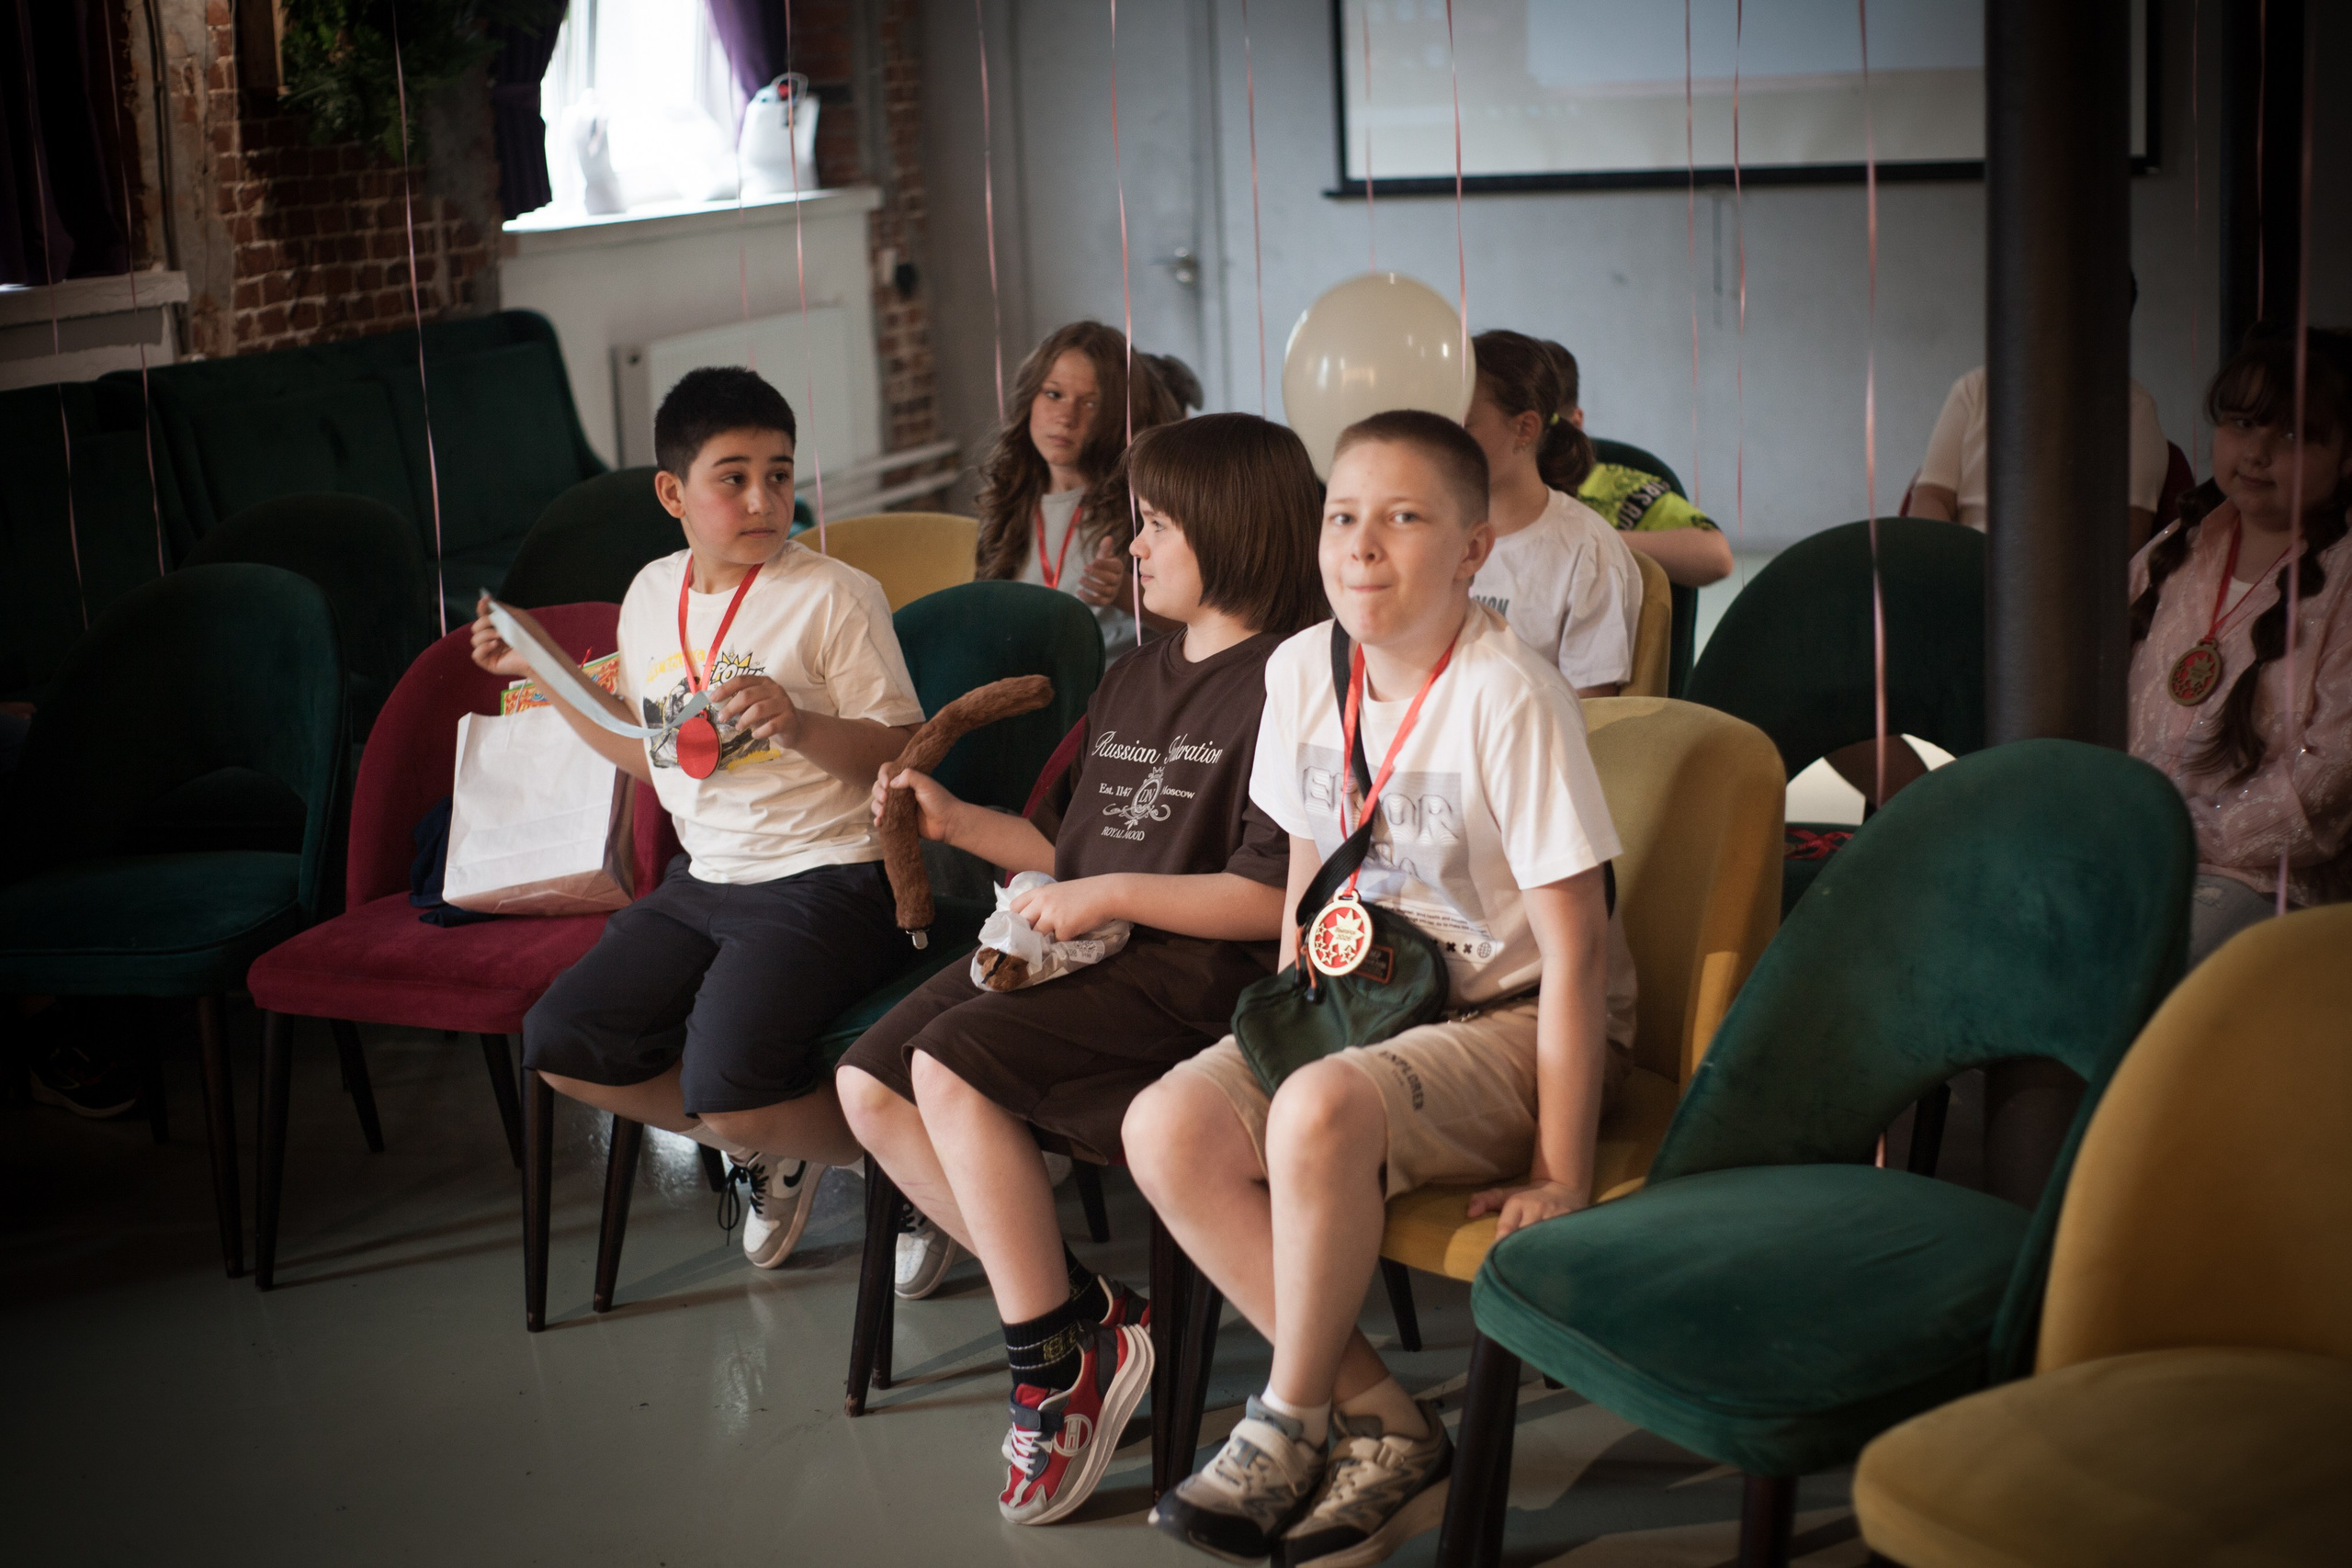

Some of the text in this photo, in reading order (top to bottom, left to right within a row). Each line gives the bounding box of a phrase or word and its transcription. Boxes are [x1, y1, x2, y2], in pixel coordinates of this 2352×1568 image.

[1091, 731, 1161, 764] Russian
[1099, 783, 1114, 795] Est.
[1115, 785, 1133, 797] 1147
[1101, 826, 1124, 839] ROYAL
